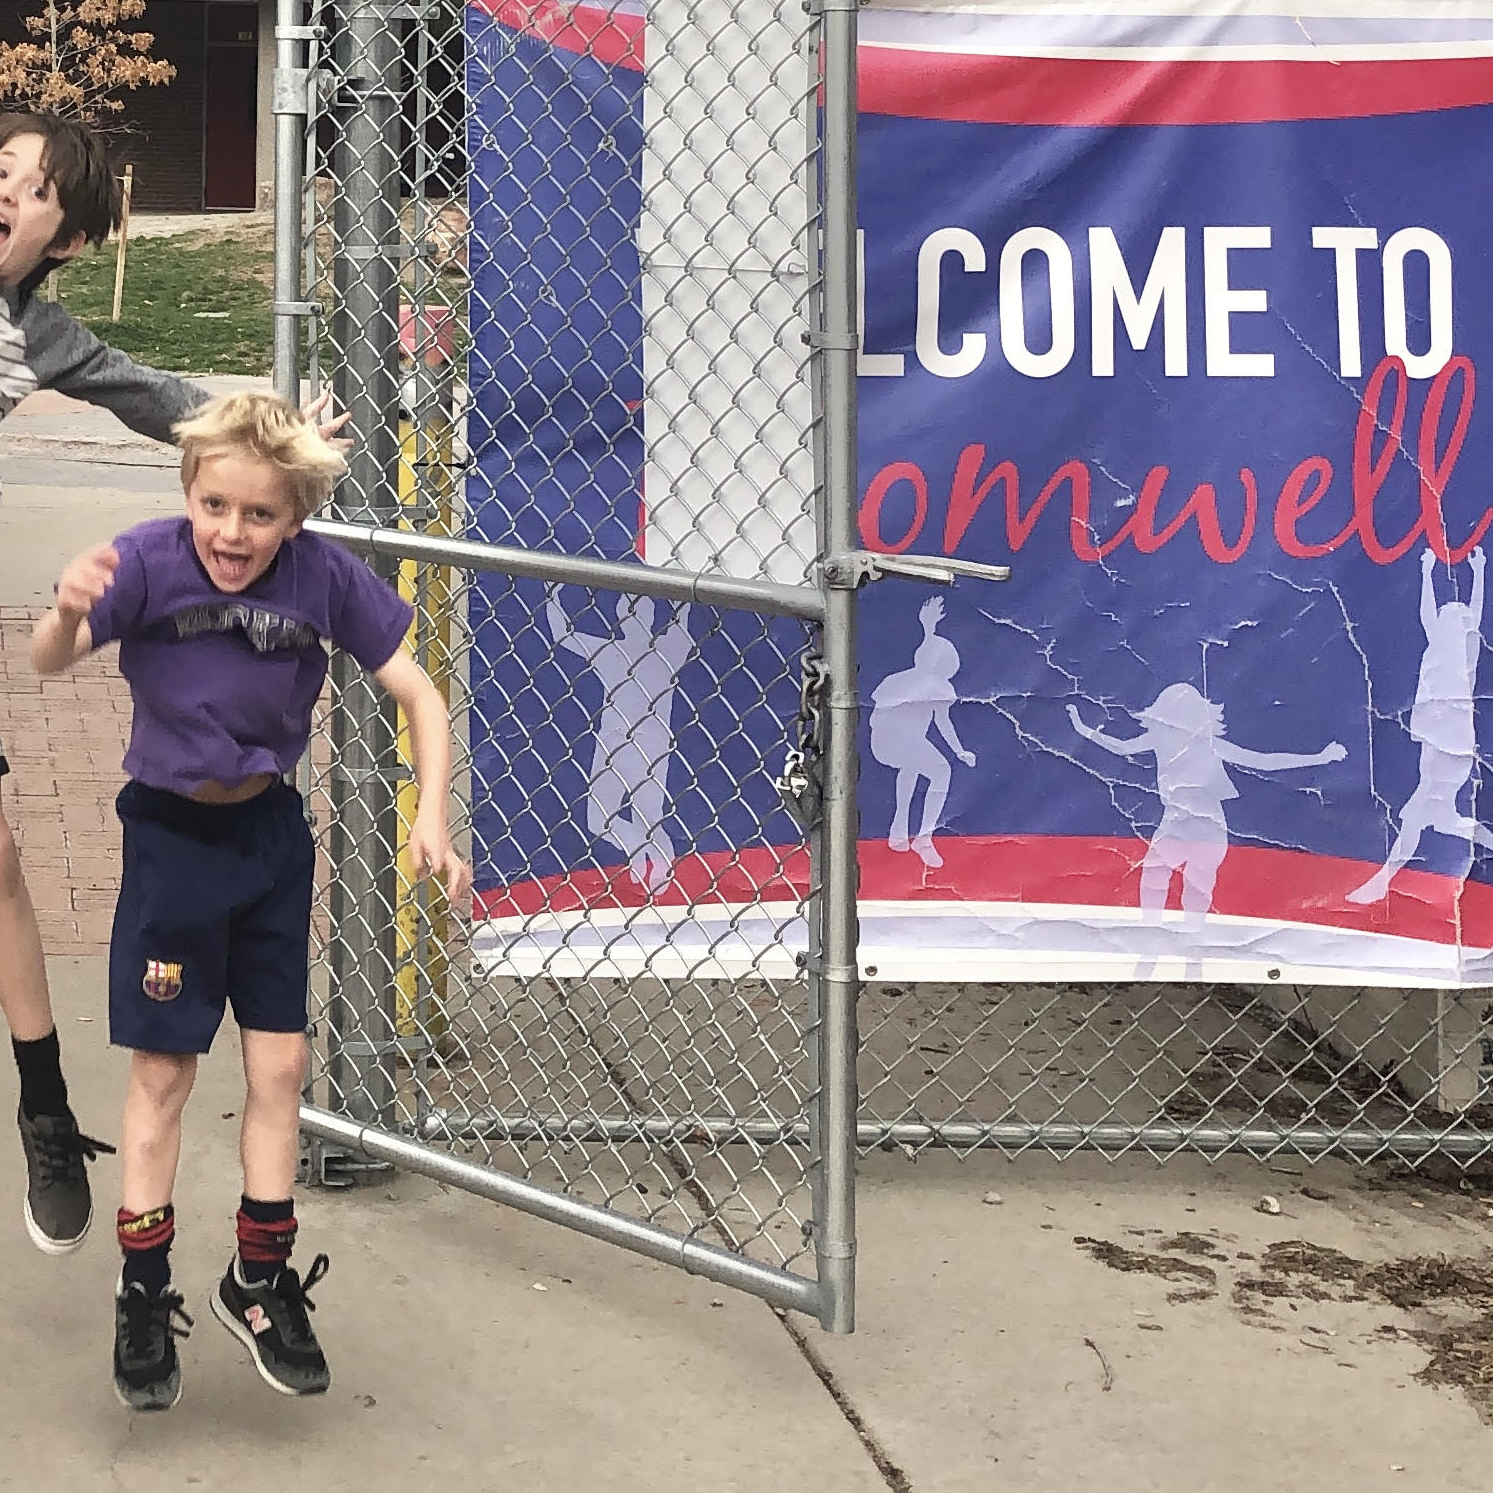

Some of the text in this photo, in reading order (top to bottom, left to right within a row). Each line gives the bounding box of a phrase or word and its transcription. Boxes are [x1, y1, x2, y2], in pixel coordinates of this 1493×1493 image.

[856, 226, 1454, 380] LCOME TO
[856, 355, 1493, 565] omwell
